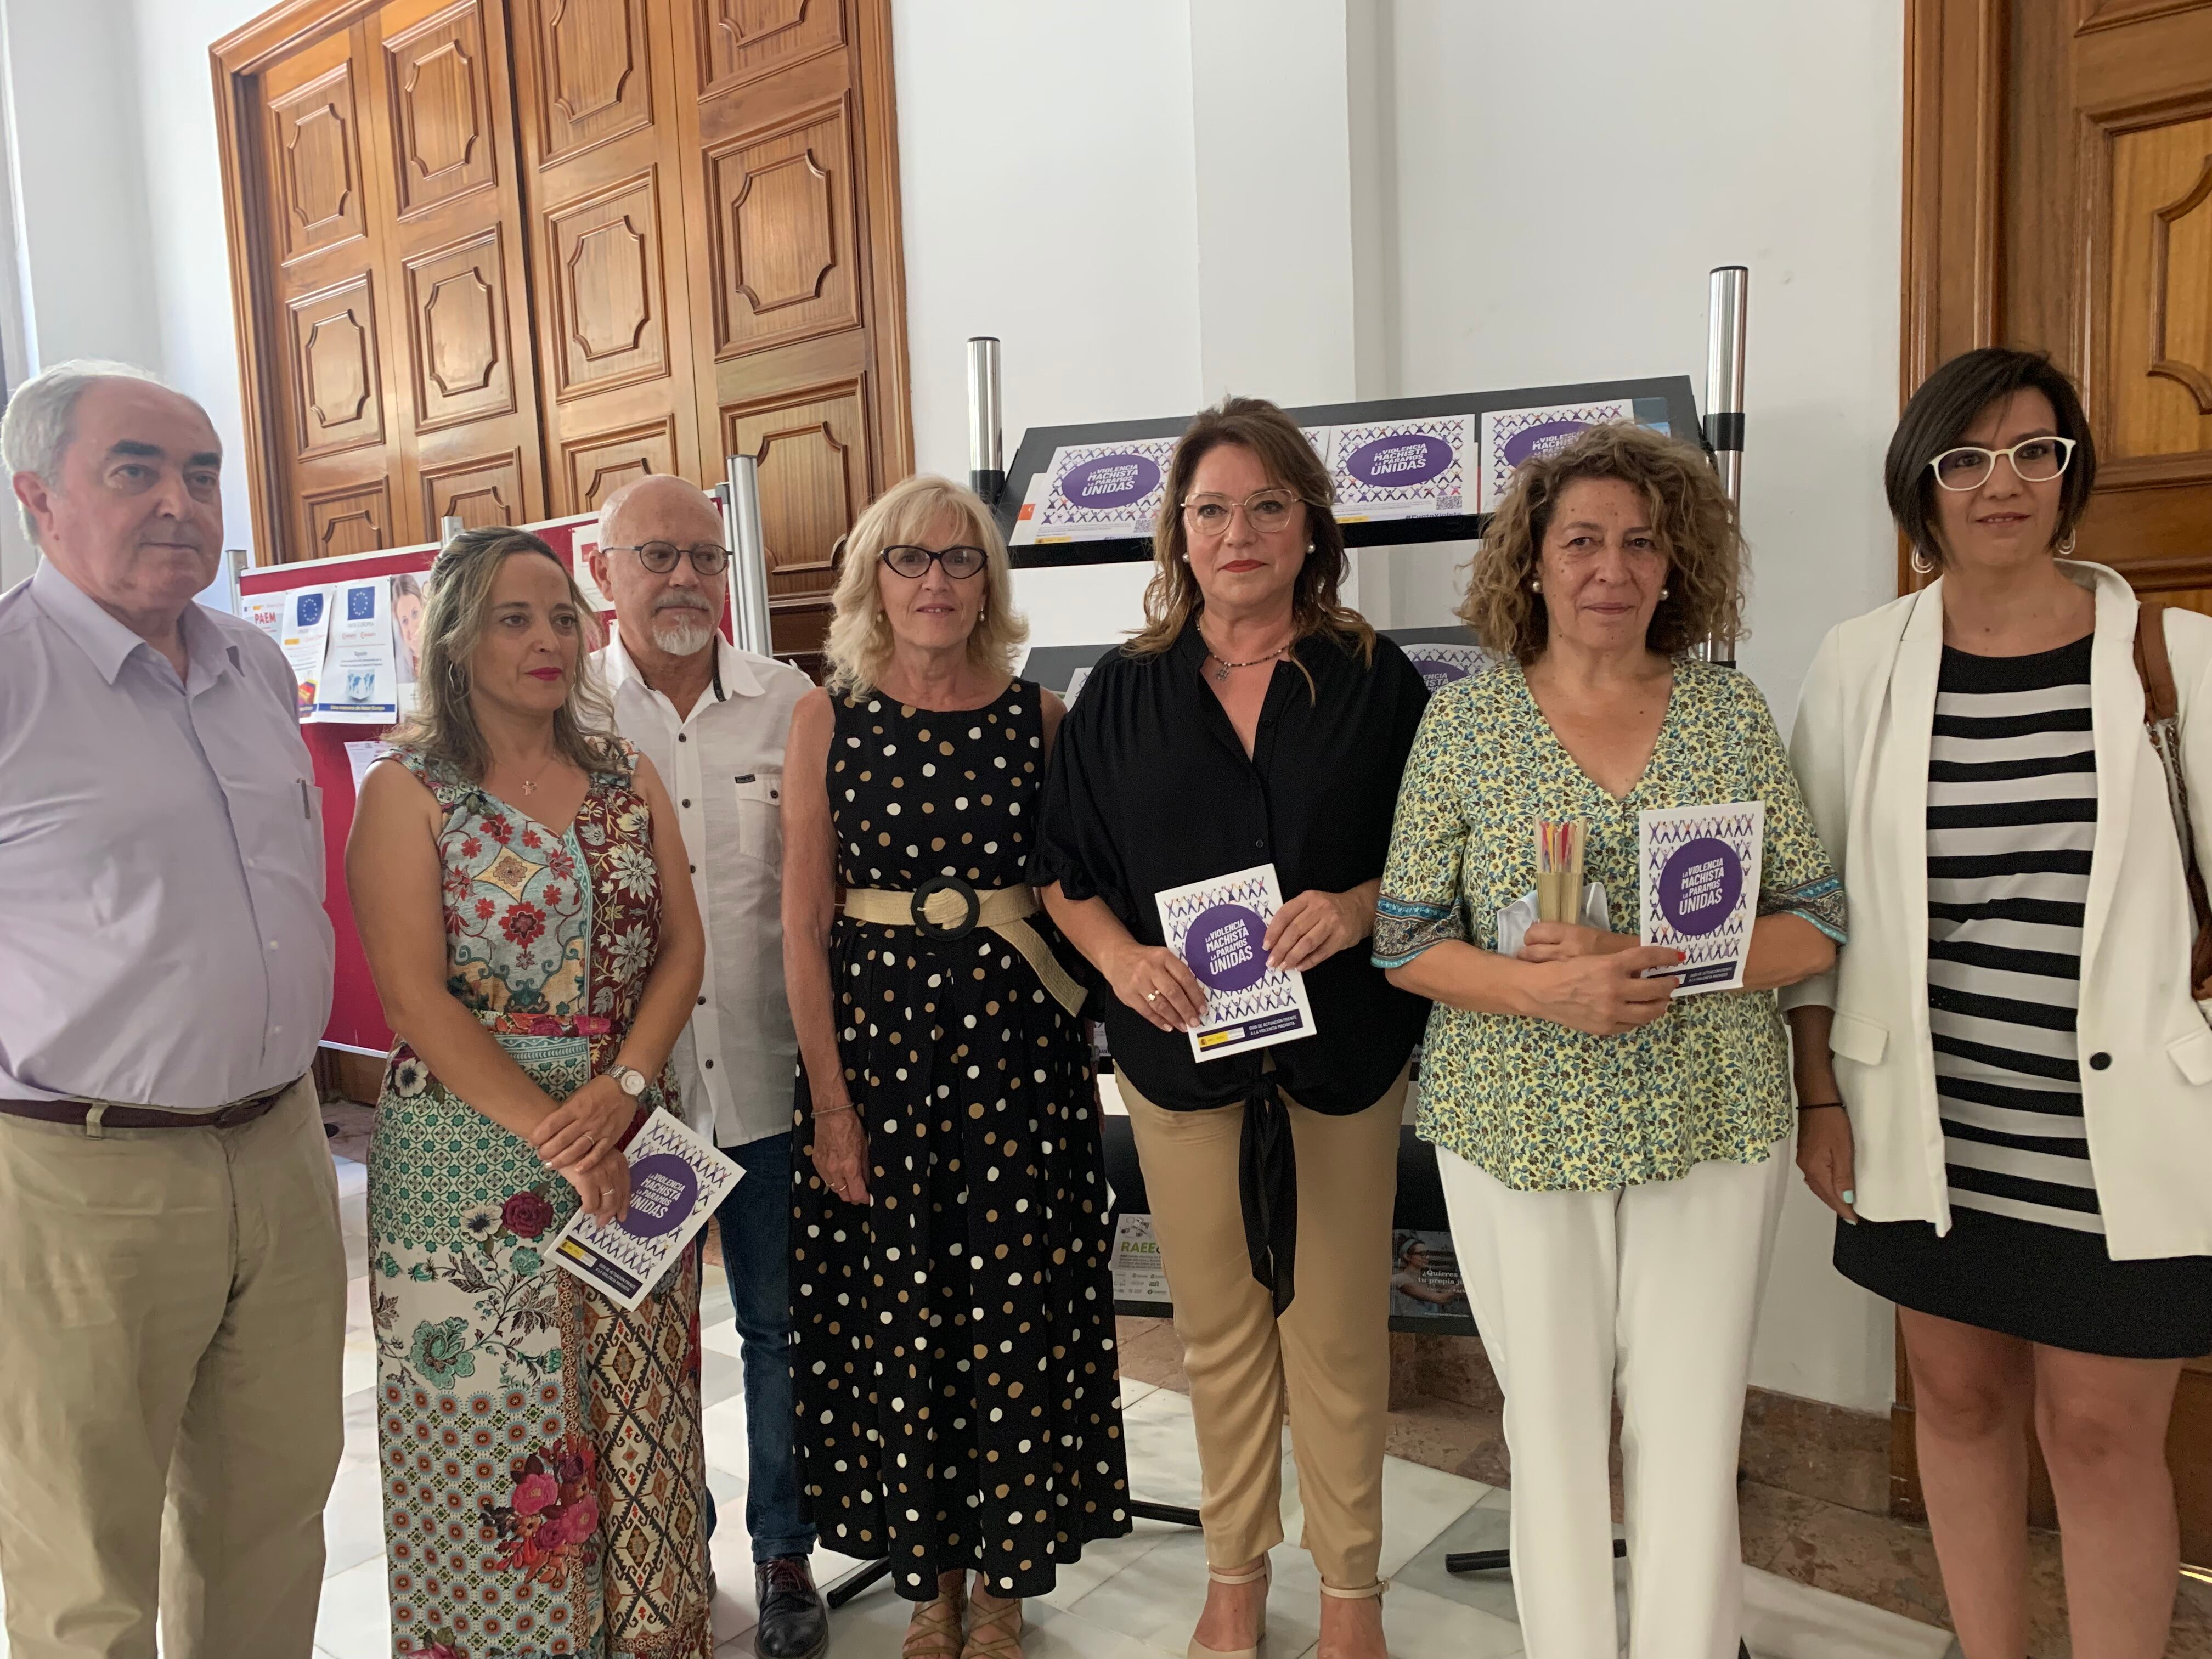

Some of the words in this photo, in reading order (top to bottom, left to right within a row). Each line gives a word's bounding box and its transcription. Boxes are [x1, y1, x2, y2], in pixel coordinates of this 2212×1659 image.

[1383, 443, 1426, 454] VIOLENCIA
[1532, 438, 1577, 450] MACHIS
[1374, 448, 1427, 461] MACHISTA
[1383, 454, 1424, 465] PARAMOS
[1087, 469, 1138, 481] MACHISTA
[1097, 464, 1138, 474] VIOLENCIA
[1371, 459, 1426, 476] UNIDAS
[1082, 481, 1135, 496] UNIDAS
[1095, 476, 1133, 485] PARAMOS
[255, 611, 276, 624] PAEM
[1688, 857, 1723, 876] VIOLENCIA
[1681, 867, 1724, 890] MACHISTA
[1689, 879, 1721, 897] PARAMOS
[1679, 888, 1723, 916] UNIDAS
[1210, 919, 1245, 940] VIOLENCIA
[1206, 927, 1249, 953] MACHISTA
[1216, 938, 1248, 958] PARAMOS
[1210, 945, 1253, 975] UNIDAS
[641, 1178, 681, 1201] MACHISTA
[653, 1173, 686, 1192] VIOLENCIA
[641, 1189, 672, 1206] PARAMOS
